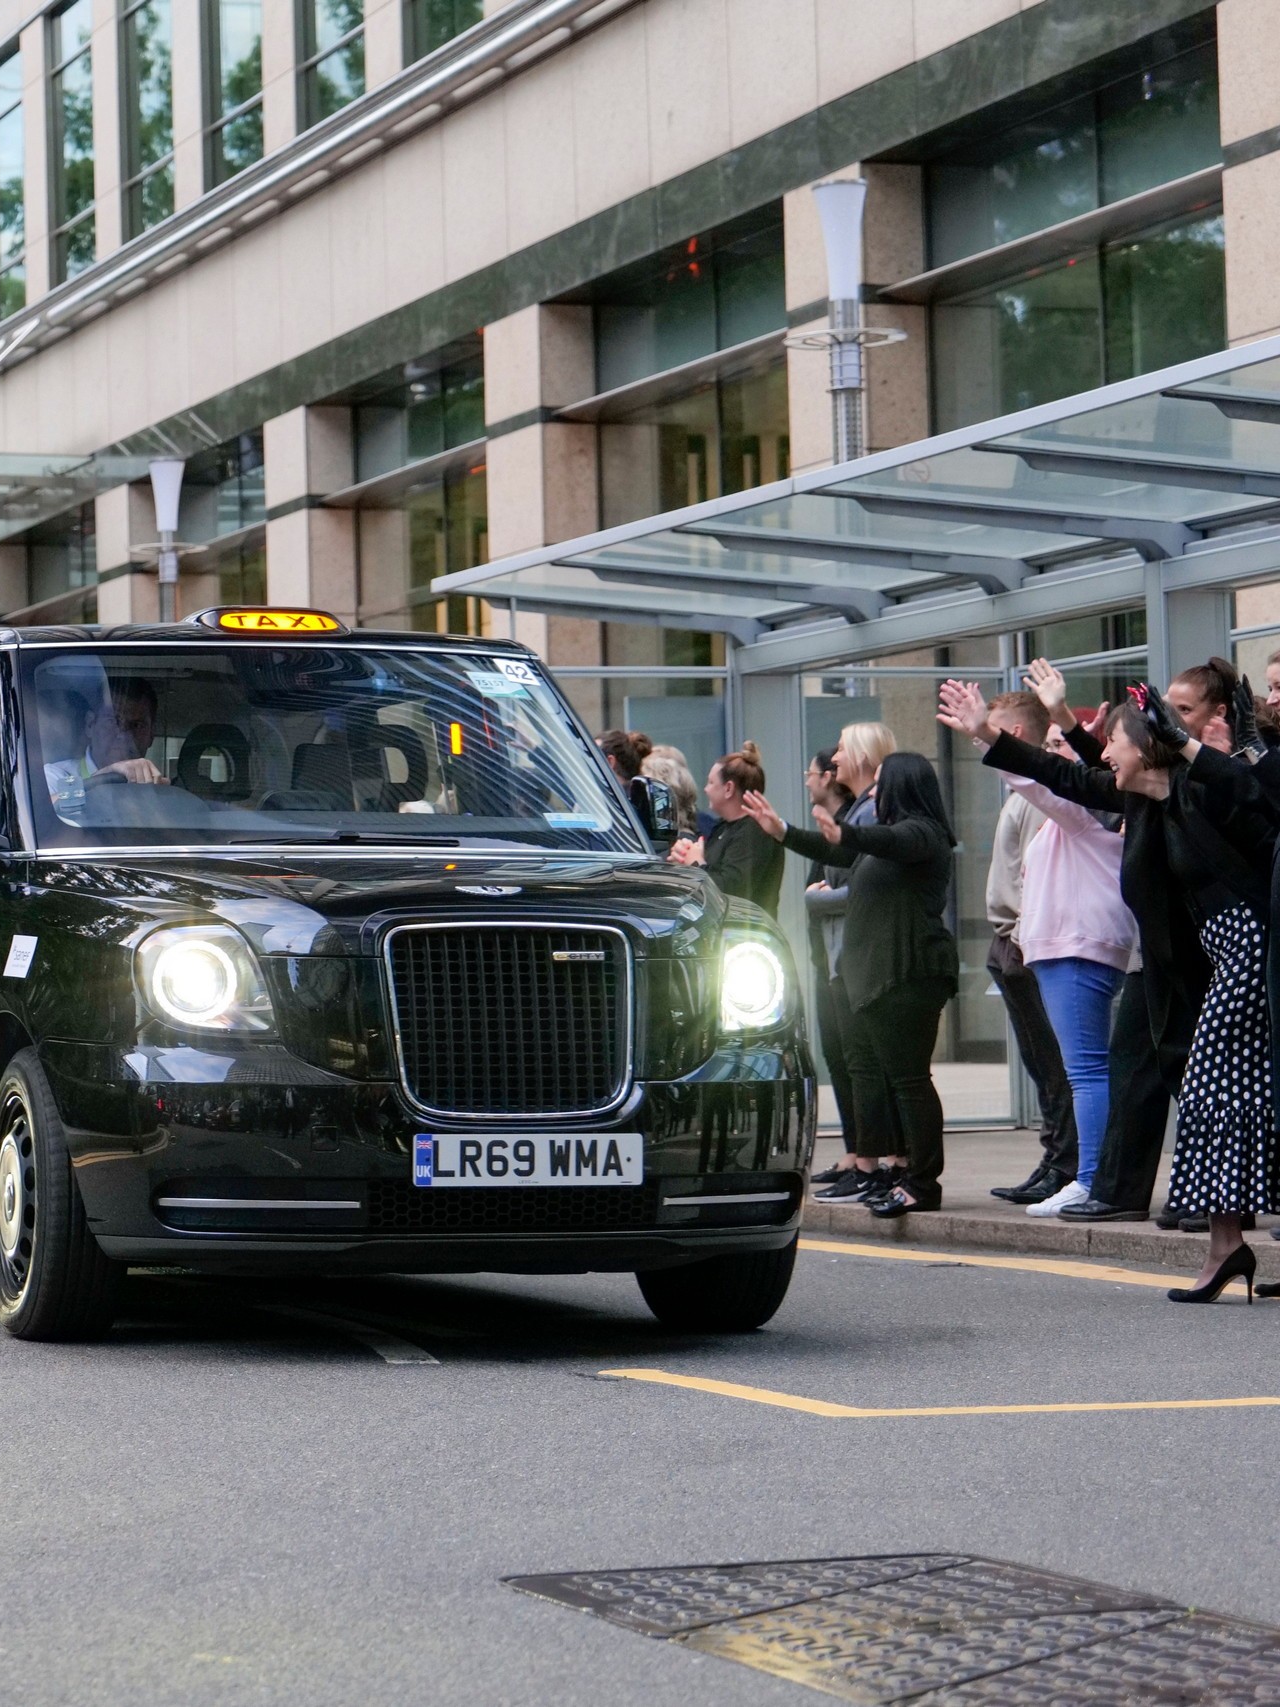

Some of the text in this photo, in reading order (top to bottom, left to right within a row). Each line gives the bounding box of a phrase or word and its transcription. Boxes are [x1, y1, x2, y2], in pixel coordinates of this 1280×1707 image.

[230, 615, 328, 628] TAXI
[505, 664, 534, 681] 42
[432, 1139, 624, 1178] LR69 WMA
[416, 1165, 431, 1178] UK
